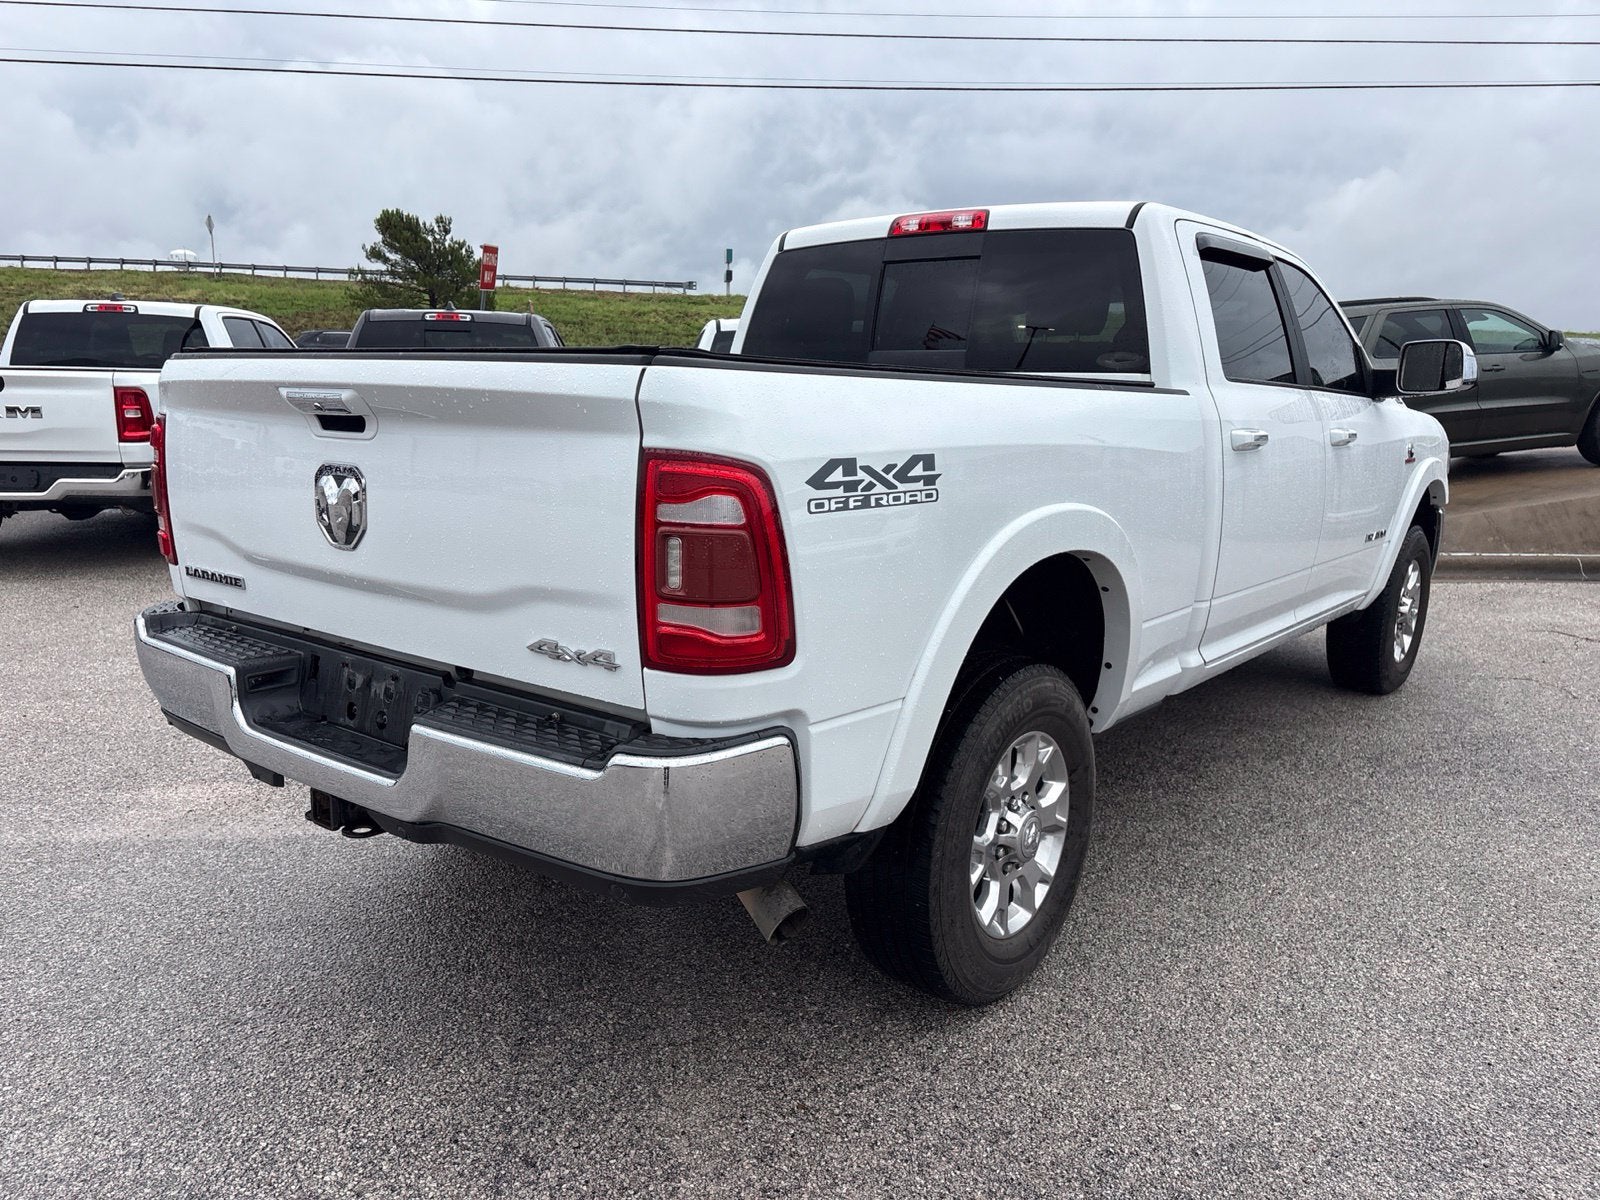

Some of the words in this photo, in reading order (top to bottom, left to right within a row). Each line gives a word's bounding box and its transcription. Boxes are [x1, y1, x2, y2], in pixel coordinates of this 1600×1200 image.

[483, 270, 494, 283] WAY
[324, 464, 354, 475] RAM
[809, 496, 865, 513] OFF
[870, 489, 937, 507] ROAD
[185, 565, 246, 590] LARAMIE
